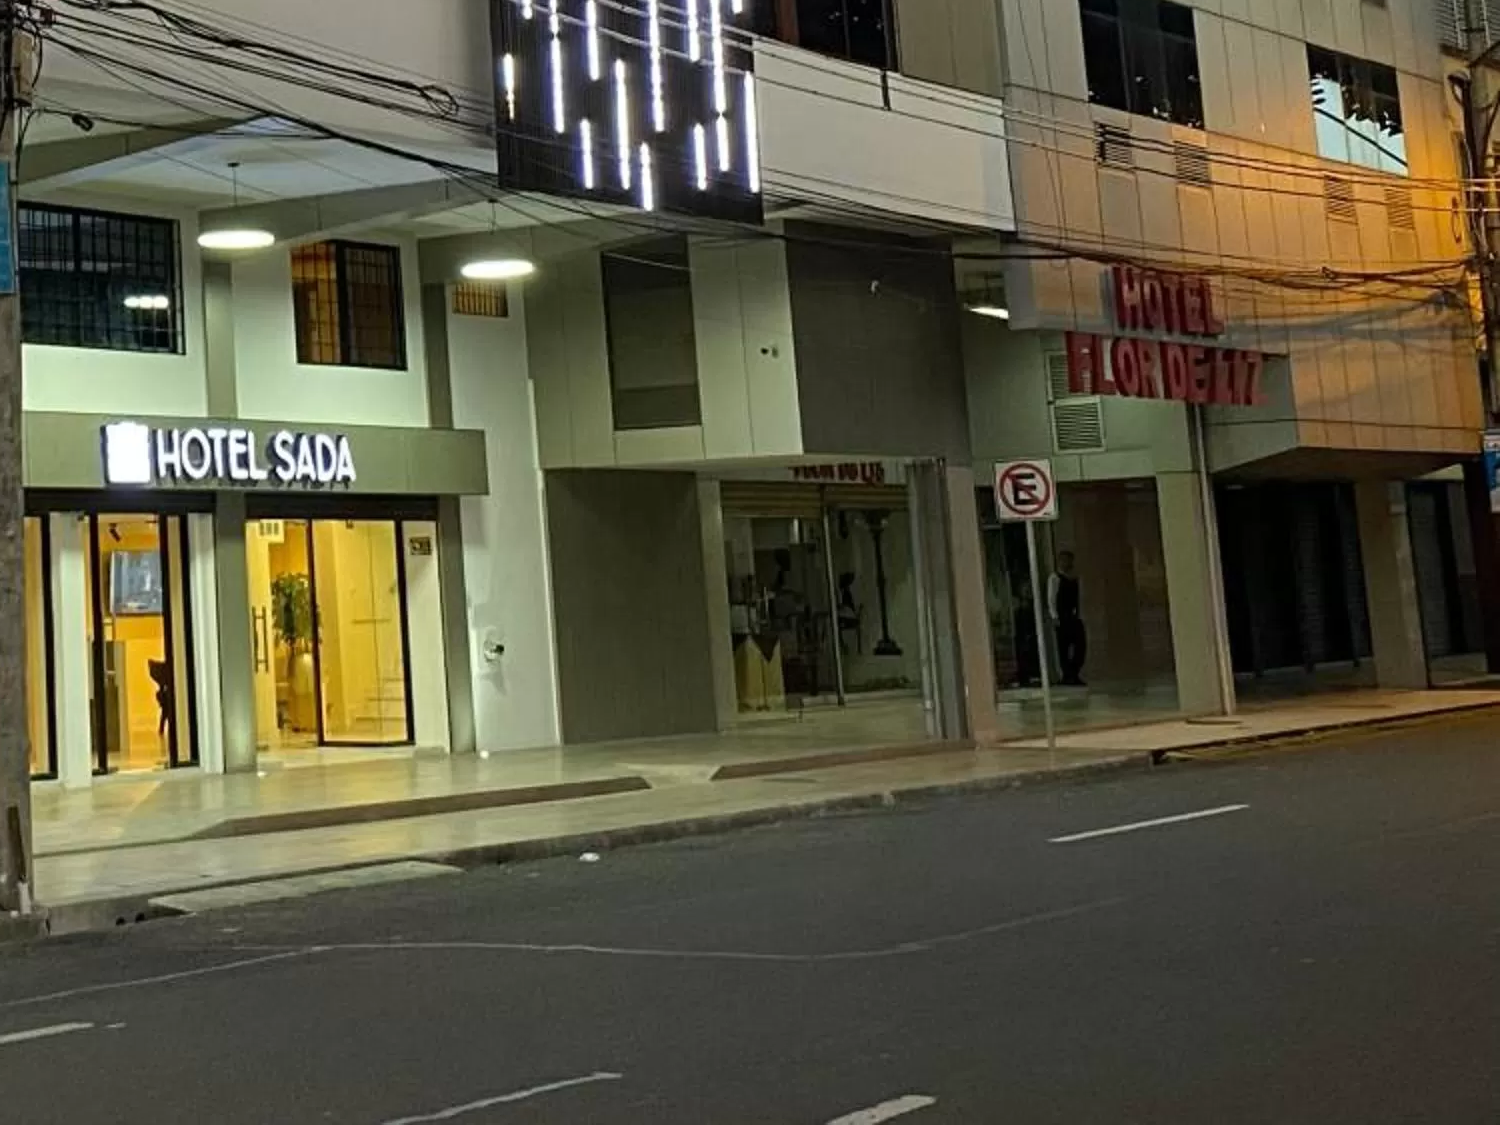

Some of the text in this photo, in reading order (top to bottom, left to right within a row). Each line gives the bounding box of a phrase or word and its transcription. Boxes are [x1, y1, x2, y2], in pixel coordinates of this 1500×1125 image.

[1113, 266, 1225, 339] HOTEL
[1066, 331, 1160, 398] FLOR
[155, 427, 357, 483] HOTEL SADA
[1011, 472, 1038, 506] E
